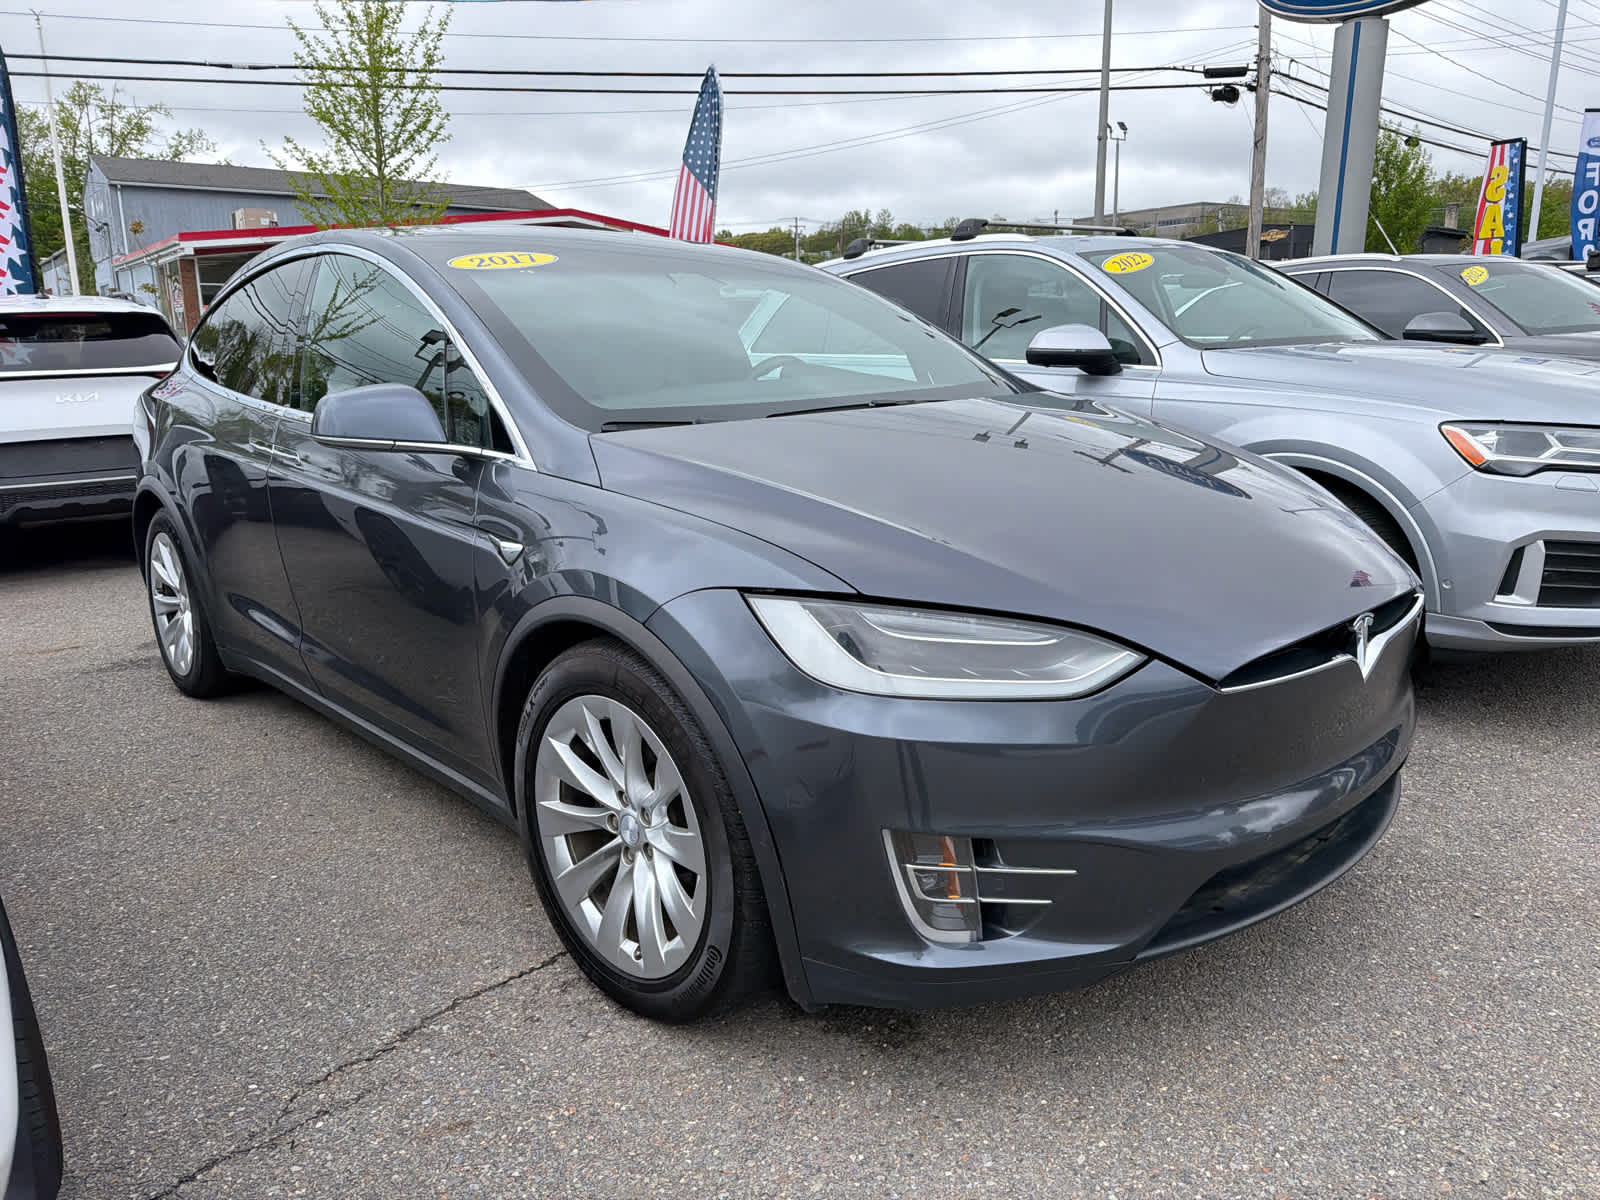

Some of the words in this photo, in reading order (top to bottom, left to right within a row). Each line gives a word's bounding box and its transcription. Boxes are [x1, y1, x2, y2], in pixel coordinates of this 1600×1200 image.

[469, 254, 536, 268] 2017
[1111, 254, 1148, 271] 2022
[679, 944, 723, 1000] Contin
